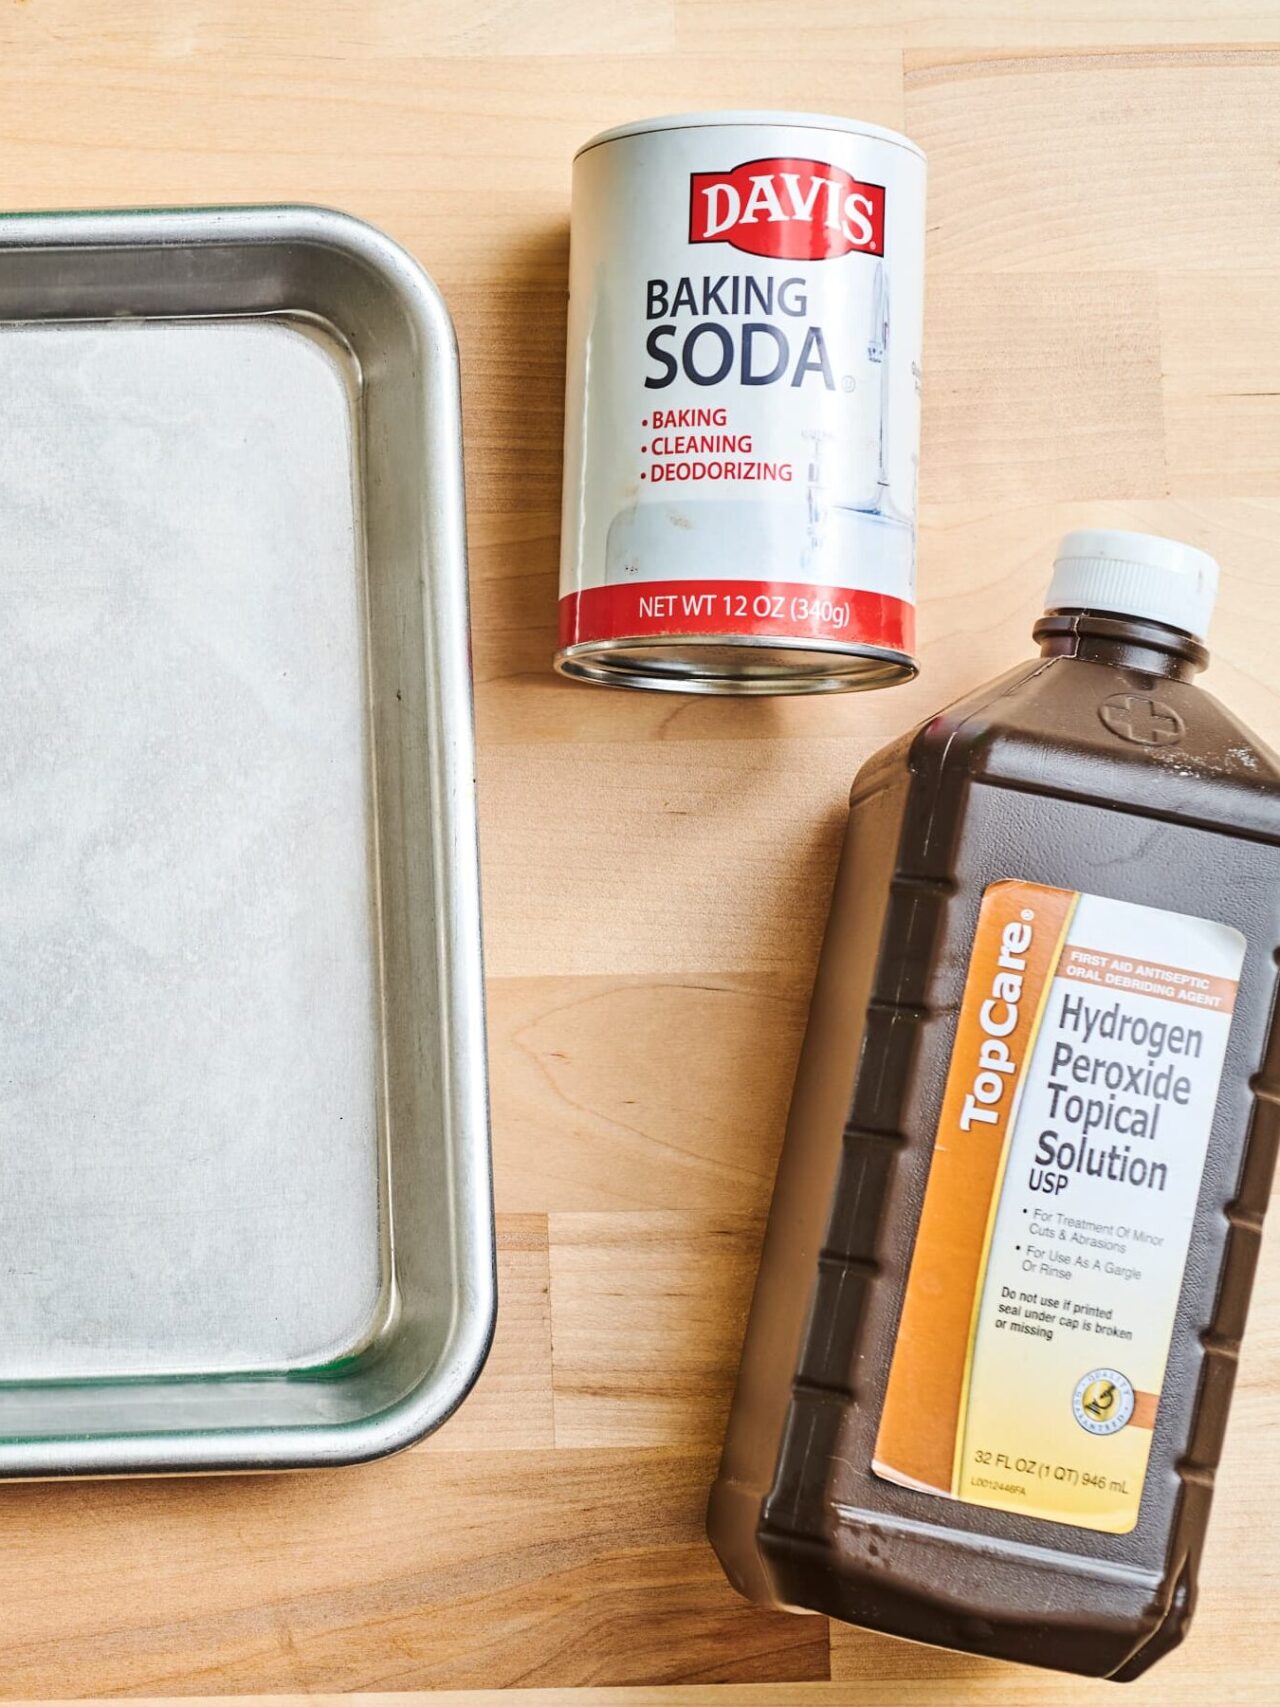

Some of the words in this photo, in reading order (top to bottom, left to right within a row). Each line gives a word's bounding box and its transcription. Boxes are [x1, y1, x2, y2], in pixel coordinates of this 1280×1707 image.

[701, 172, 873, 246] DAVIS
[645, 275, 808, 320] BAKING
[643, 321, 836, 391] SODA
[651, 408, 728, 430] BAKING
[651, 434, 753, 456] CLEANING
[650, 461, 793, 483] DEODORIZING
[639, 594, 678, 619] NET
[681, 594, 717, 617] WT
[723, 594, 748, 617] 12
[753, 595, 786, 619] OZ
[790, 598, 851, 629] (340g)
[1066, 965, 1102, 982] ORAL
[1104, 973, 1176, 997] DEBRIDING
[1177, 989, 1224, 1008] AGENT
[1071, 951, 1110, 967] FIRST
[1110, 959, 1134, 973] AID
[1135, 965, 1211, 990] ANTISEPTIC
[959, 919, 1034, 1132] TopCare
[1058, 993, 1205, 1059] Hydrogen
[1050, 1041, 1192, 1105] Peroxide
[1047, 1081, 1161, 1140] Topical
[1034, 1130, 1168, 1192] Solution
[1028, 1168, 1069, 1196] USP
[1029, 1222, 1056, 1239] Cuts
[1059, 1229, 1067, 1241] &
[1069, 1231, 1127, 1255] Abrasions
[1033, 1208, 1054, 1222] For
[1056, 1213, 1114, 1237] Treatment
[1118, 1226, 1130, 1239] Of
[1132, 1228, 1165, 1247] Minor
[1021, 1260, 1037, 1273] Or
[1040, 1262, 1073, 1281] Rinse
[1026, 1245, 1047, 1259] For
[1049, 1249, 1071, 1265] Use
[1073, 1256, 1089, 1270] As
[1092, 1260, 1102, 1271] A
[1105, 1261, 1142, 1281] Gargle
[998, 1302, 1021, 1316] seal
[1024, 1306, 1056, 1323] under
[1059, 1315, 1079, 1330] cap
[1082, 1319, 1092, 1332] is
[1095, 1322, 1133, 1341] broken
[1001, 1286, 1017, 1299] Do
[1019, 1290, 1037, 1304] not
[1041, 1296, 1060, 1309] use
[1063, 1299, 1072, 1311] if
[1073, 1301, 1113, 1321] printed
[995, 1319, 1006, 1330] or
[1010, 1320, 1054, 1342] missing
[974, 1450, 992, 1465] 32
[995, 1454, 1012, 1470] FL
[1015, 1458, 1038, 1475] OZ
[1038, 1464, 1051, 1479] (1
[1053, 1466, 1080, 1486] QT)
[1081, 1472, 1107, 1490] 946
[1109, 1480, 1129, 1495] mL
